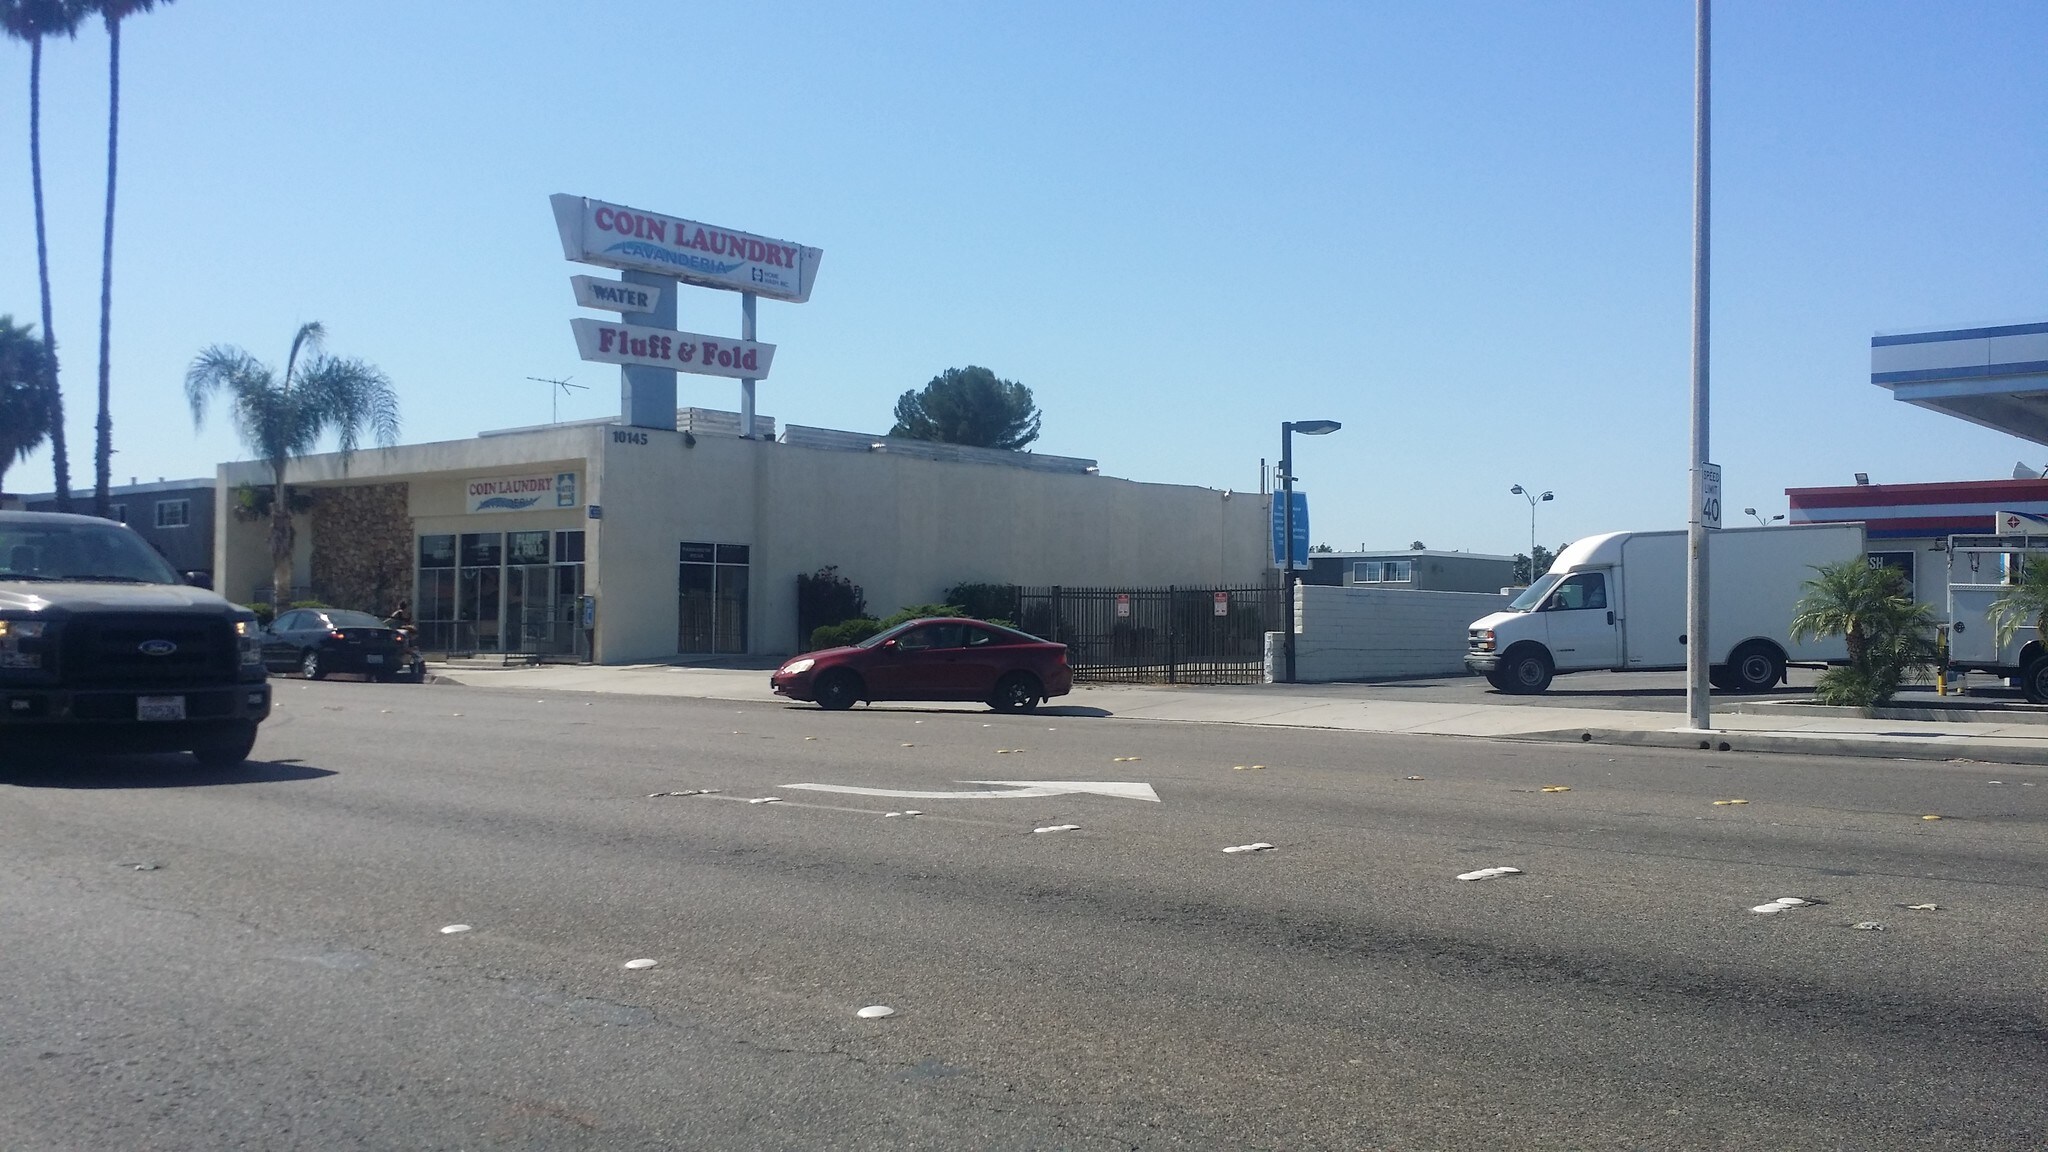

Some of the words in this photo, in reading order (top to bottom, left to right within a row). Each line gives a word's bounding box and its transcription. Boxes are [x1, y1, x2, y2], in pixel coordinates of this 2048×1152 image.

[595, 207, 667, 242] COIN
[675, 222, 797, 269] LAUNDRY
[622, 244, 727, 273] LAVANDERIA
[592, 285, 648, 307] WATER
[599, 328, 671, 360] Fluff
[677, 341, 697, 363] &
[702, 341, 759, 372] Fold
[612, 430, 649, 446] 10145
[1703, 470, 1720, 483] SPEED
[469, 481, 497, 496] COIN
[498, 477, 553, 494] LAUNDRY
[1704, 483, 1718, 494] LIMIT
[1703, 497, 1720, 522] 40
[522, 544, 544, 556] FOLD
[1867, 556, 1884, 570] SH
